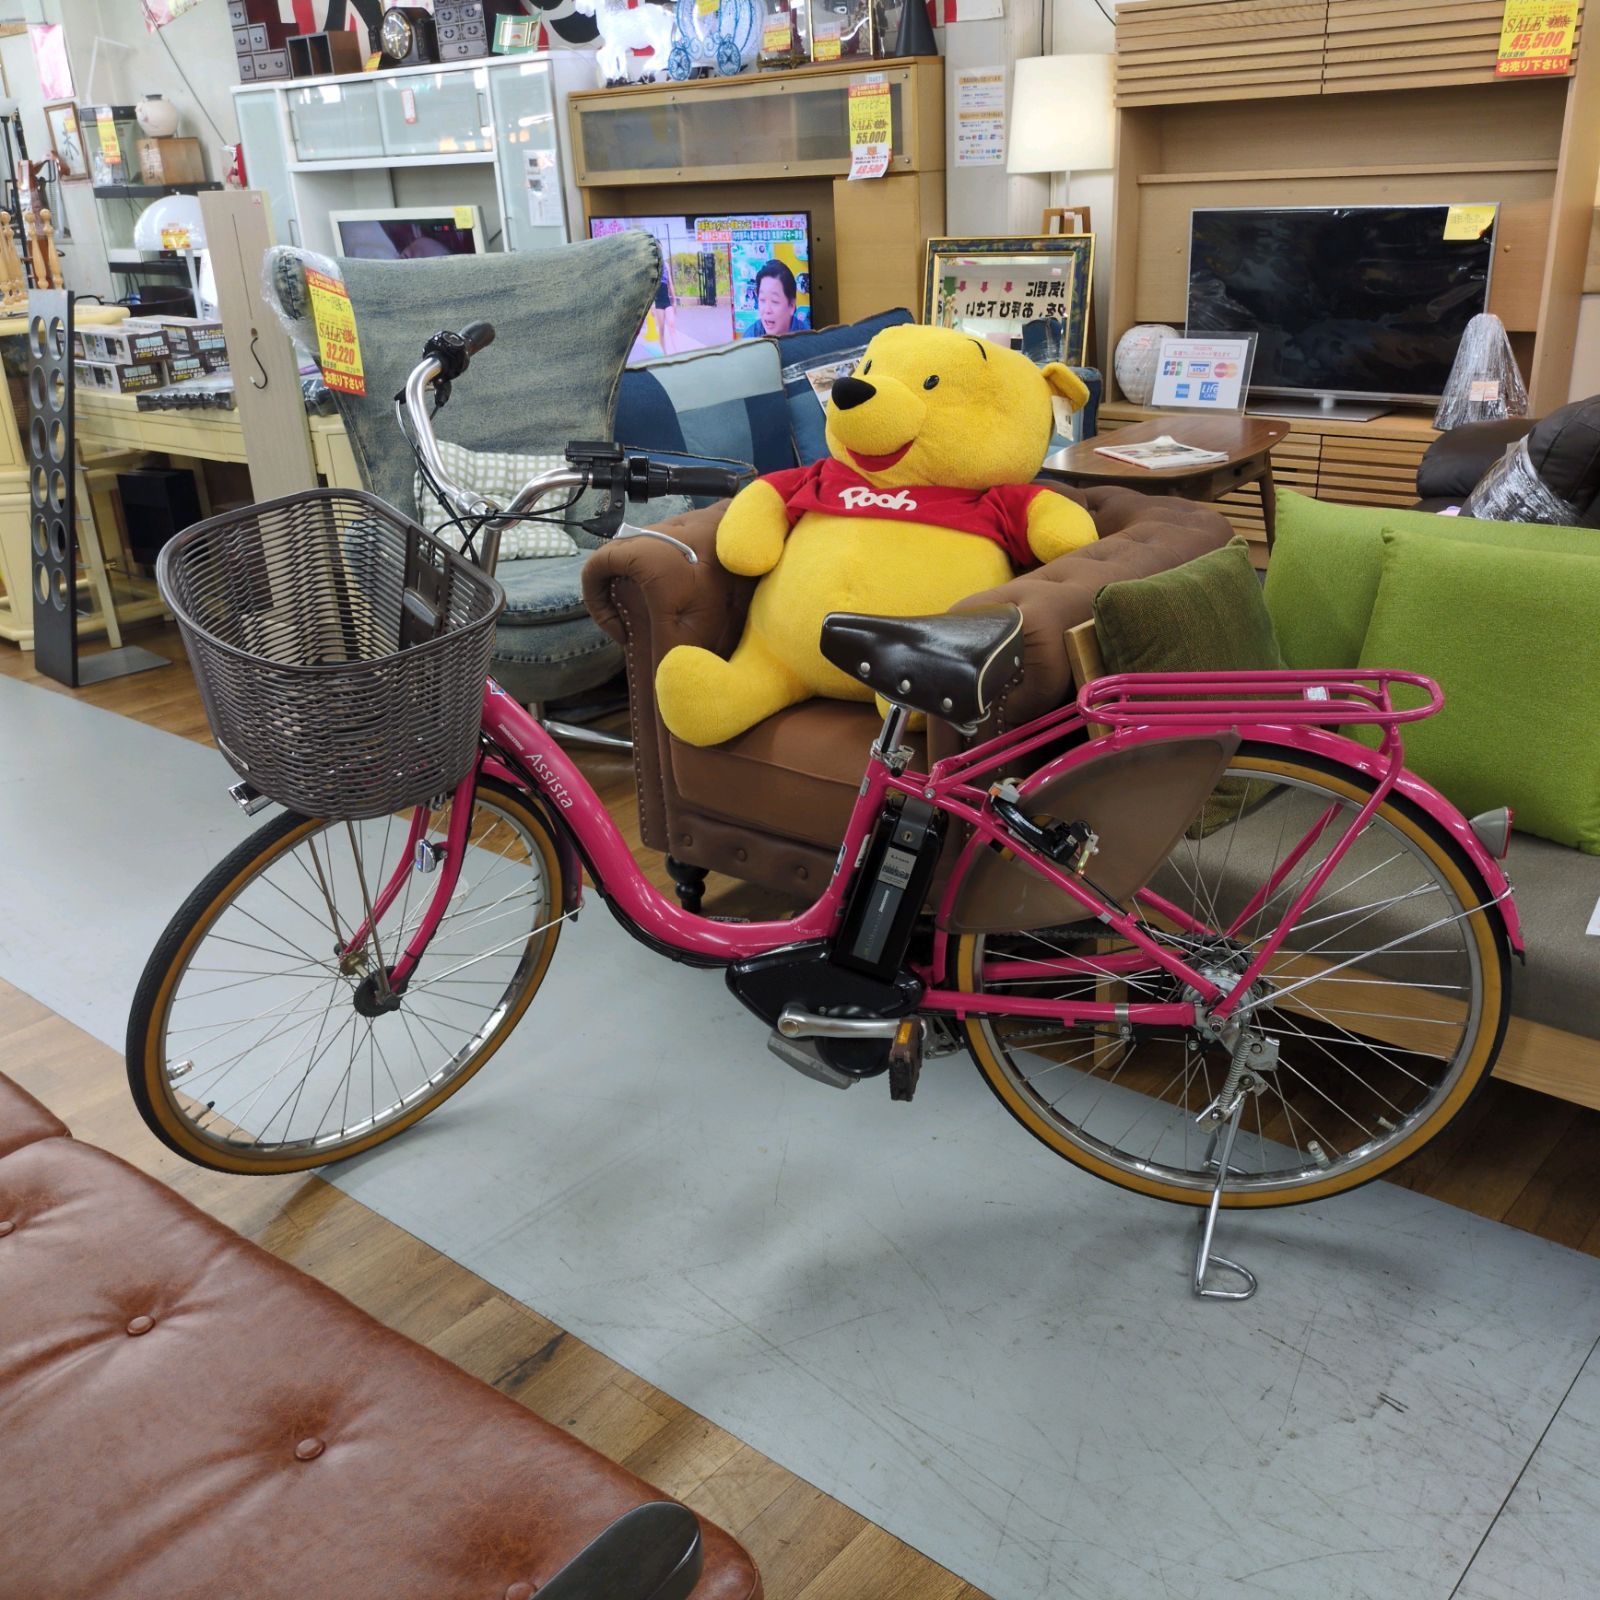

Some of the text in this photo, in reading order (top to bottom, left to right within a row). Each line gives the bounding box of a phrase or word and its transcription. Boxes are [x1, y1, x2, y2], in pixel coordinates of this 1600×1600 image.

[1504, 16, 1544, 33] SALE
[1509, 31, 1565, 51] 45,500
[319, 322, 343, 343] SALE
[326, 341, 355, 366] 32,220
[1201, 384, 1219, 394] Life
[838, 486, 917, 511] Pooh
[524, 753, 574, 809] Assista
